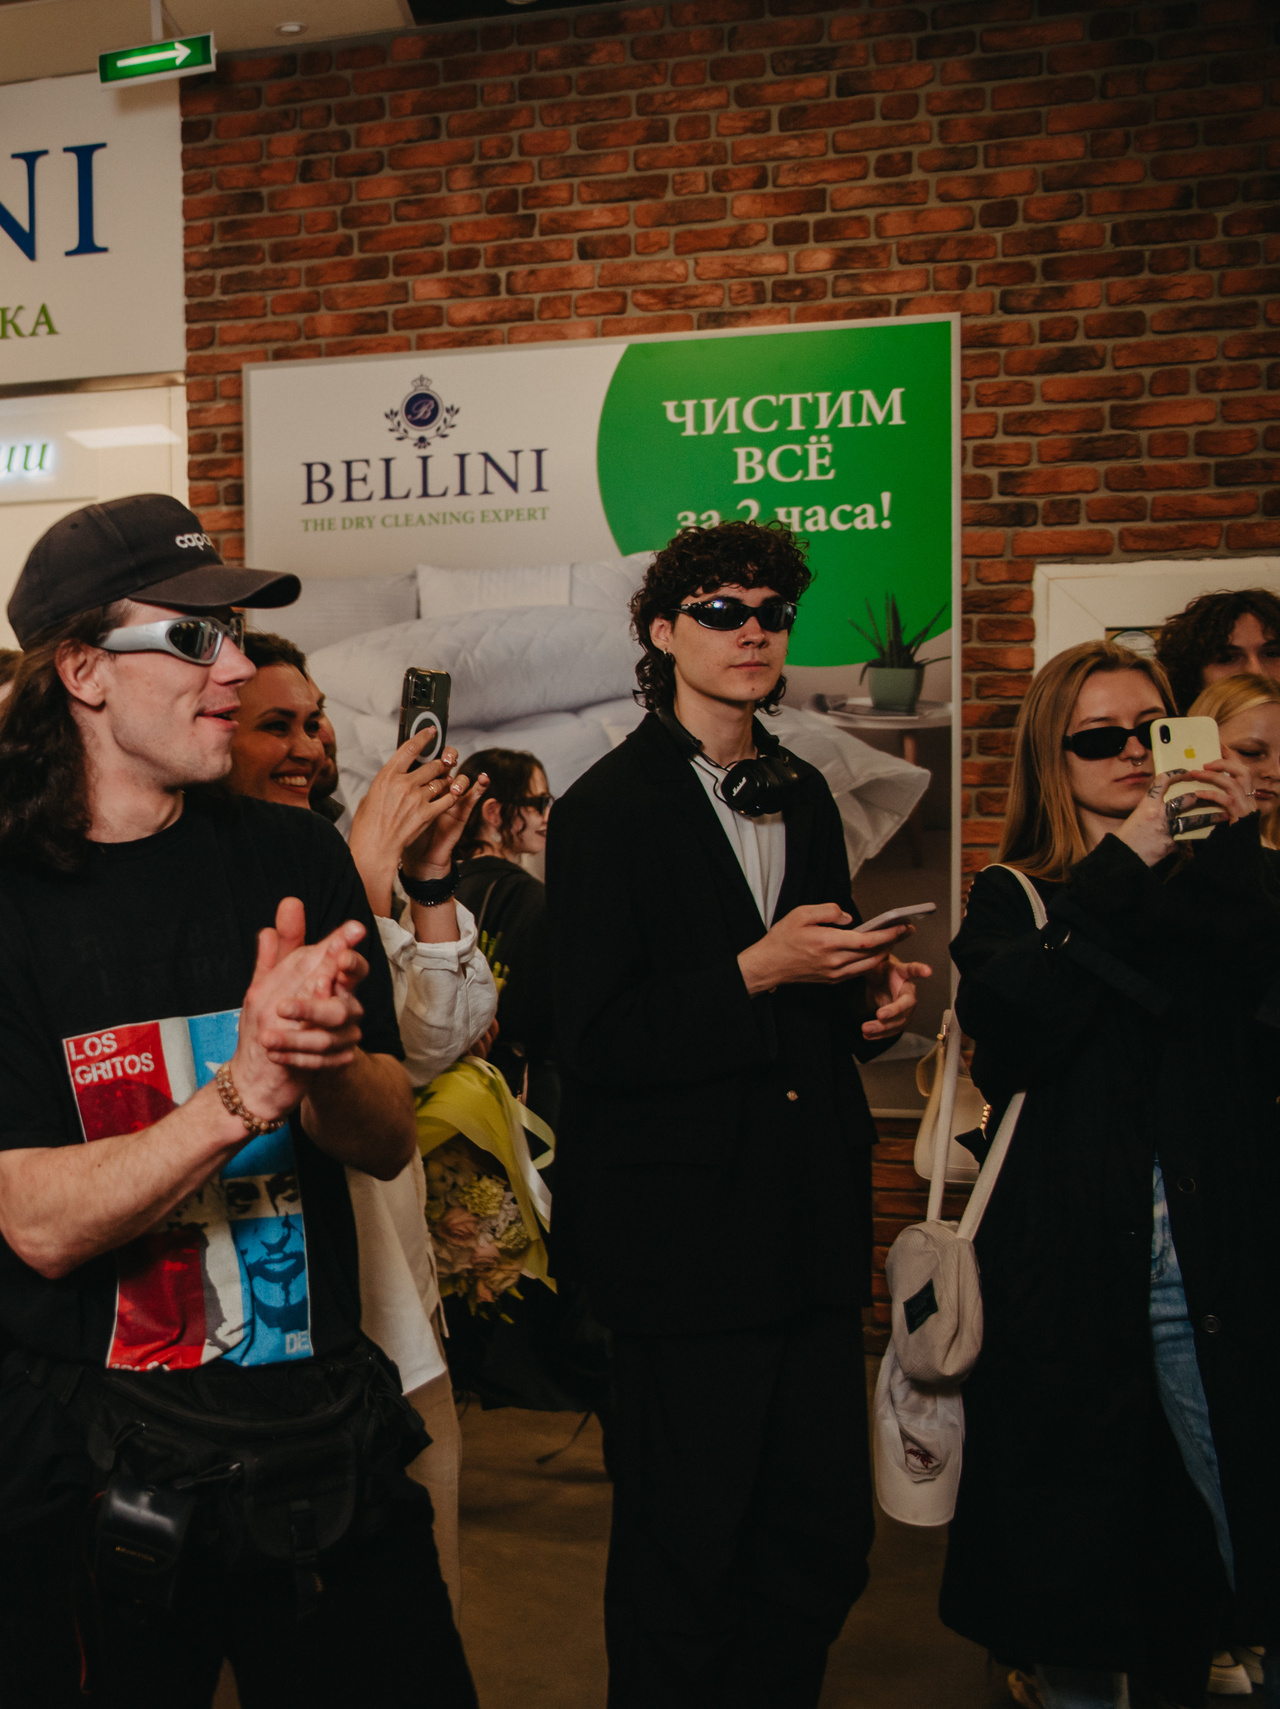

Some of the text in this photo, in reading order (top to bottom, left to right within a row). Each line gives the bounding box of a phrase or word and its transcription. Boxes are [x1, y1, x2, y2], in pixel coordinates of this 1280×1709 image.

[661, 387, 907, 437] ЧИСТИМ
[300, 447, 550, 507] BELLINI
[732, 434, 837, 485] ВСЁ
[300, 505, 551, 533] THE DRY CLEANING EXPERT
[773, 490, 892, 534] часа!
[67, 1032, 118, 1062] LOS
[74, 1051, 155, 1085] GRITOS
